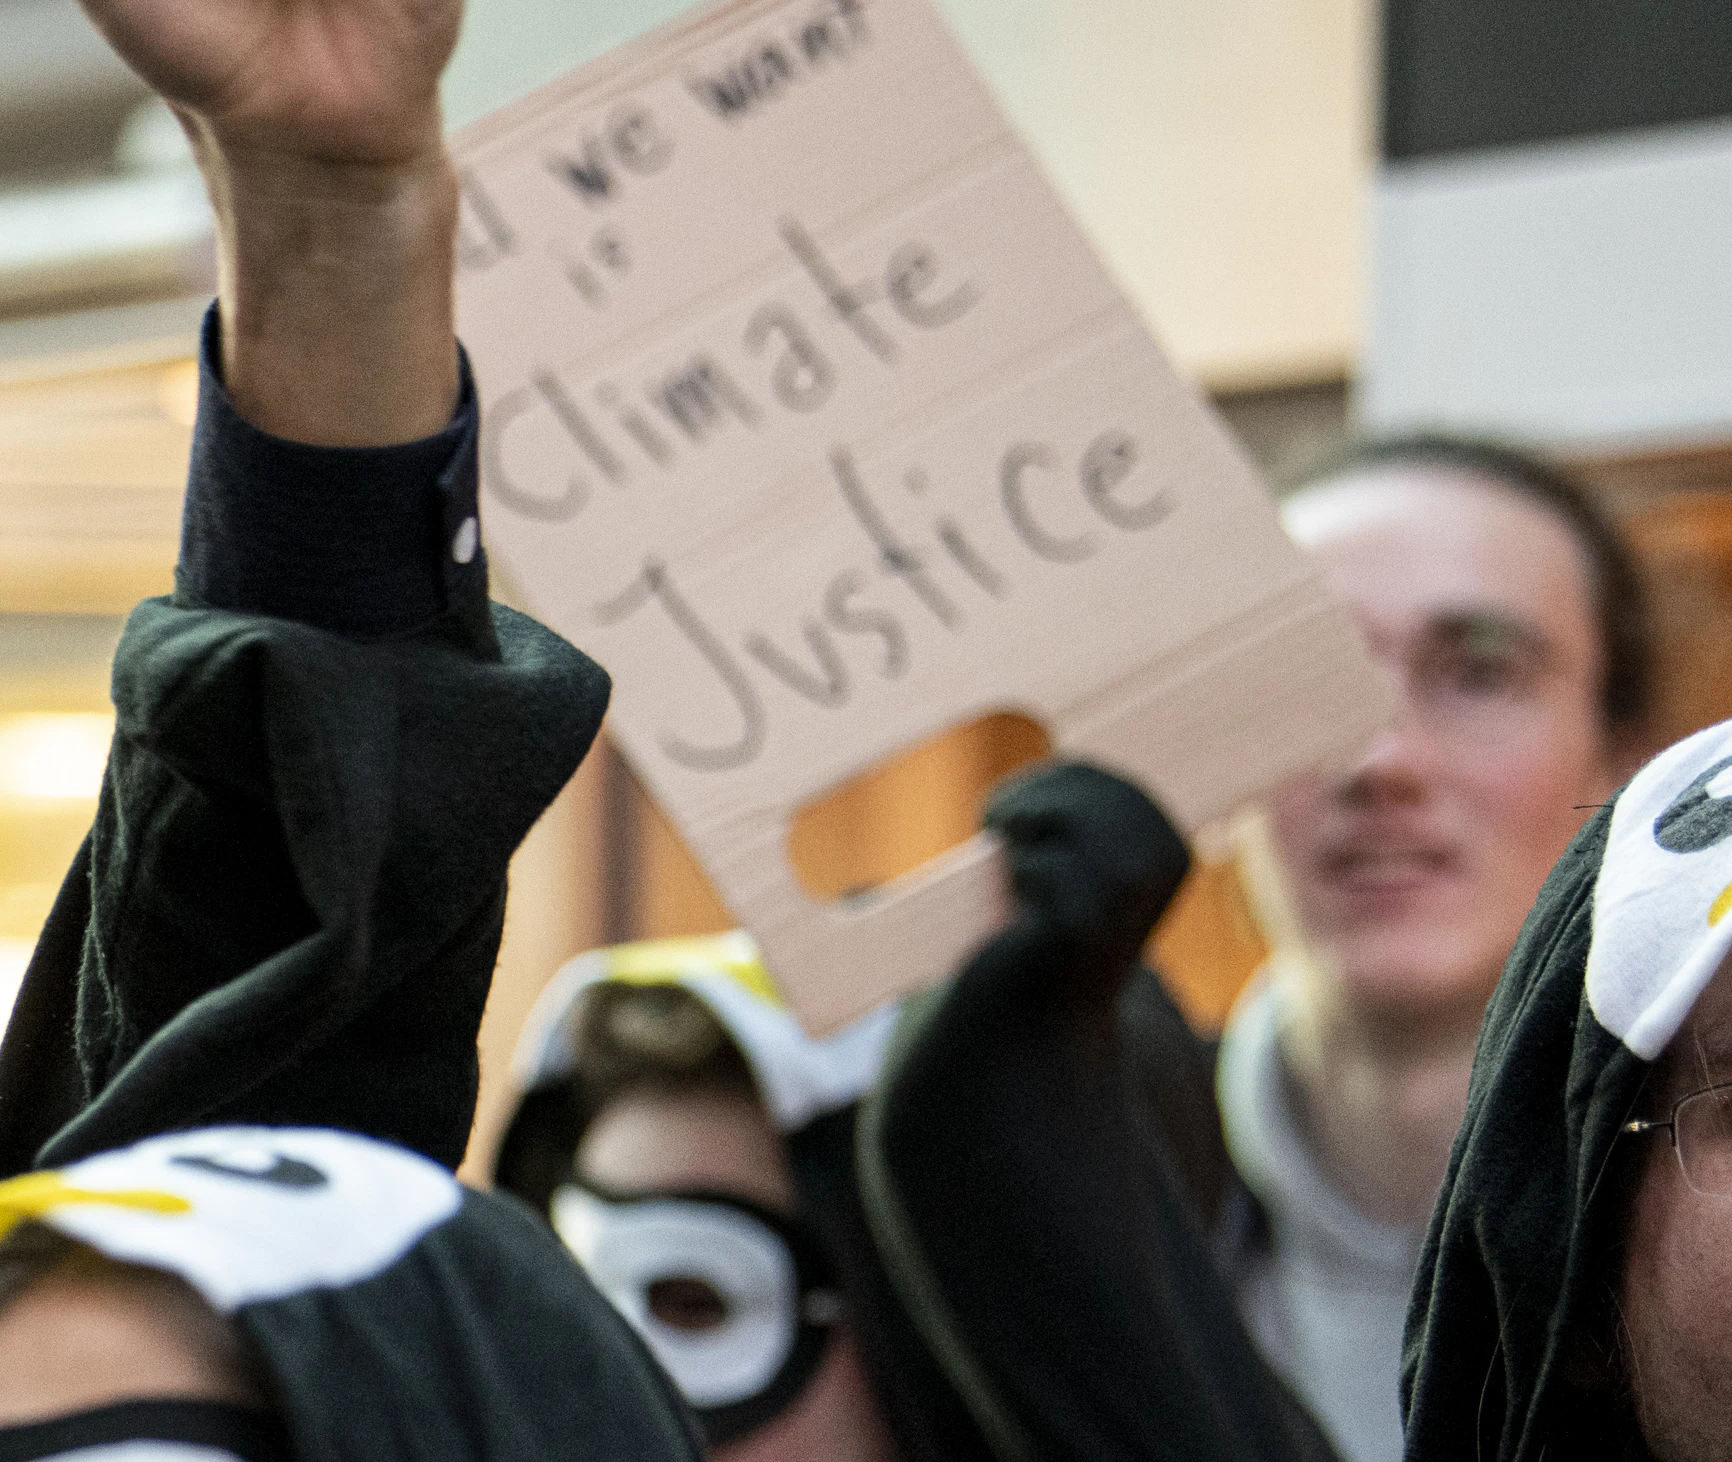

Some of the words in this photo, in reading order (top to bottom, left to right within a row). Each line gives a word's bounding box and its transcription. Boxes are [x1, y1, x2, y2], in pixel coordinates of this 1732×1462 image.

[546, 104, 674, 207] we
[478, 214, 979, 524] Climate
[598, 420, 1177, 771] Justice
